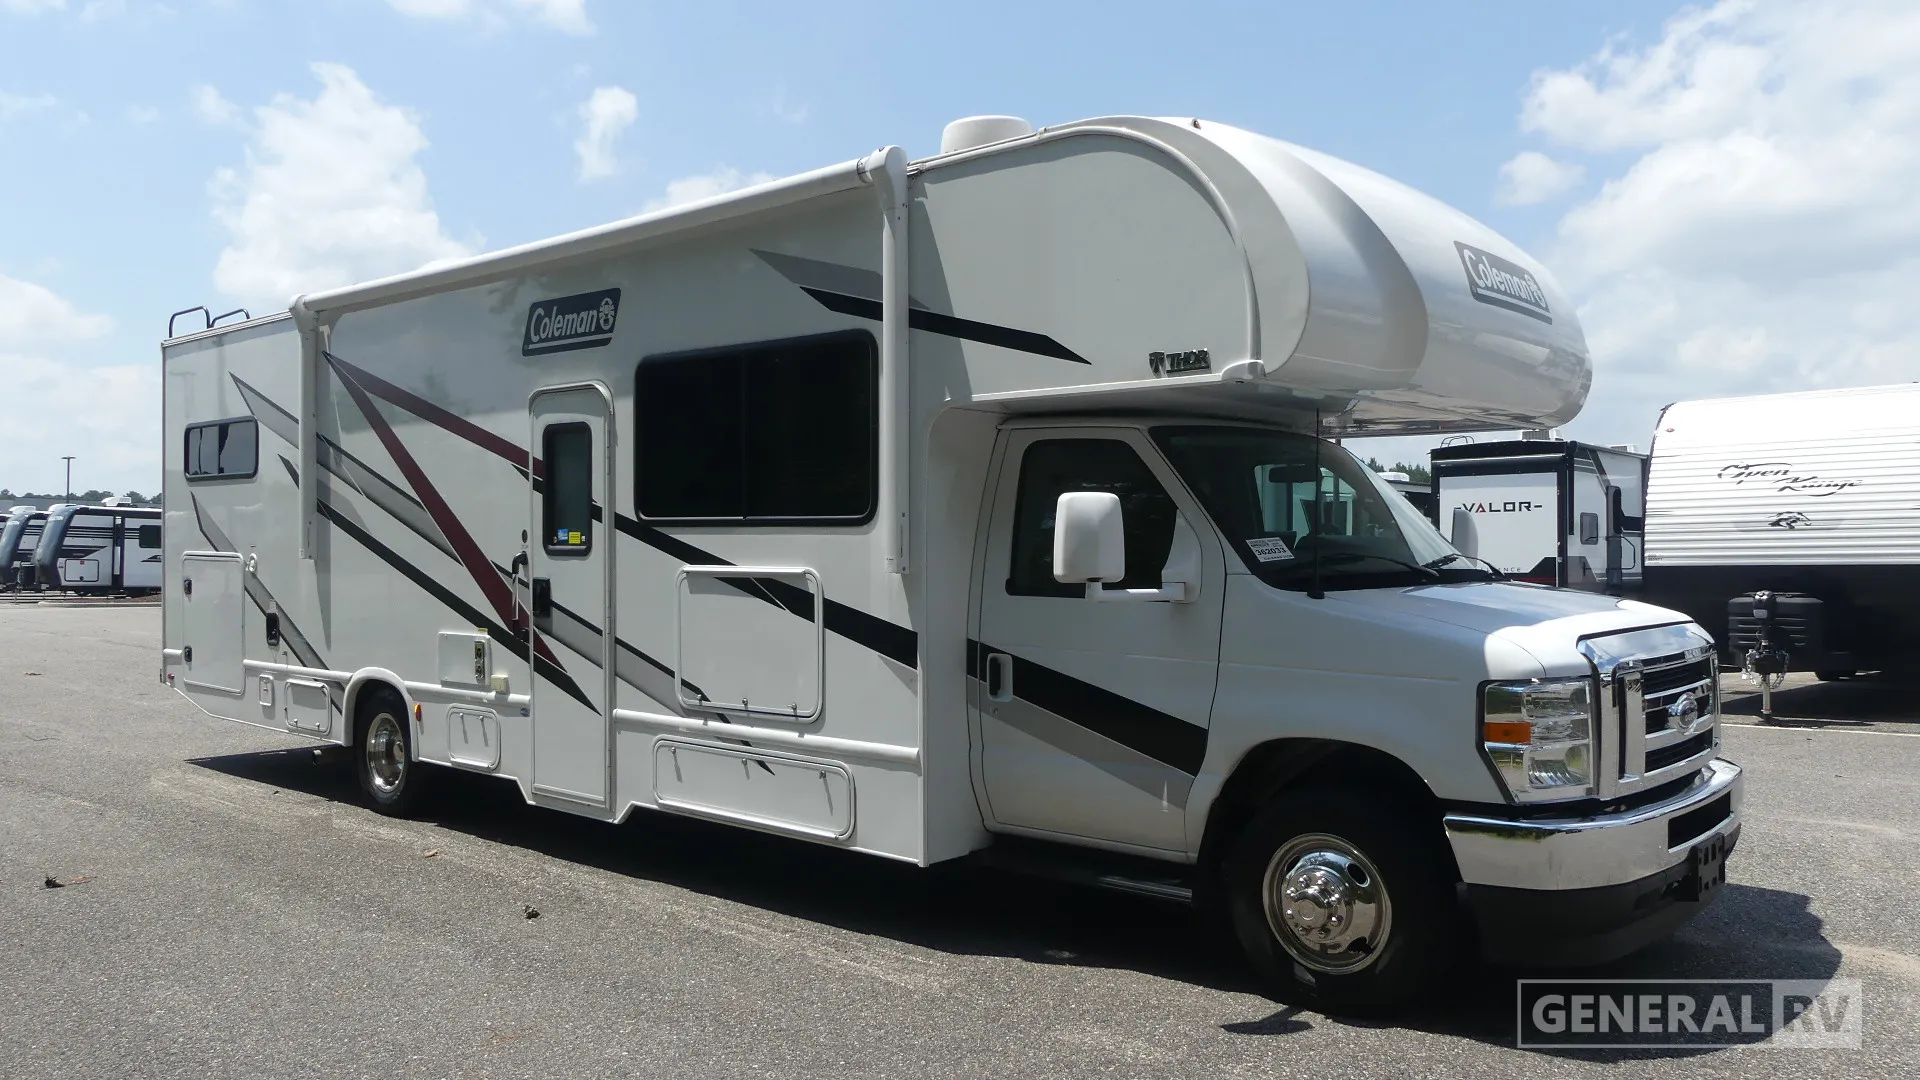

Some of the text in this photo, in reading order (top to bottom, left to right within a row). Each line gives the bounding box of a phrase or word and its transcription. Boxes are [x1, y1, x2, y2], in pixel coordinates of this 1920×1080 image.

[1463, 249, 1536, 303] Coleman
[530, 305, 598, 343] Coleman
[1166, 350, 1210, 371] THOR
[1717, 462, 1793, 485] Open
[1255, 547, 1287, 556] 362033
